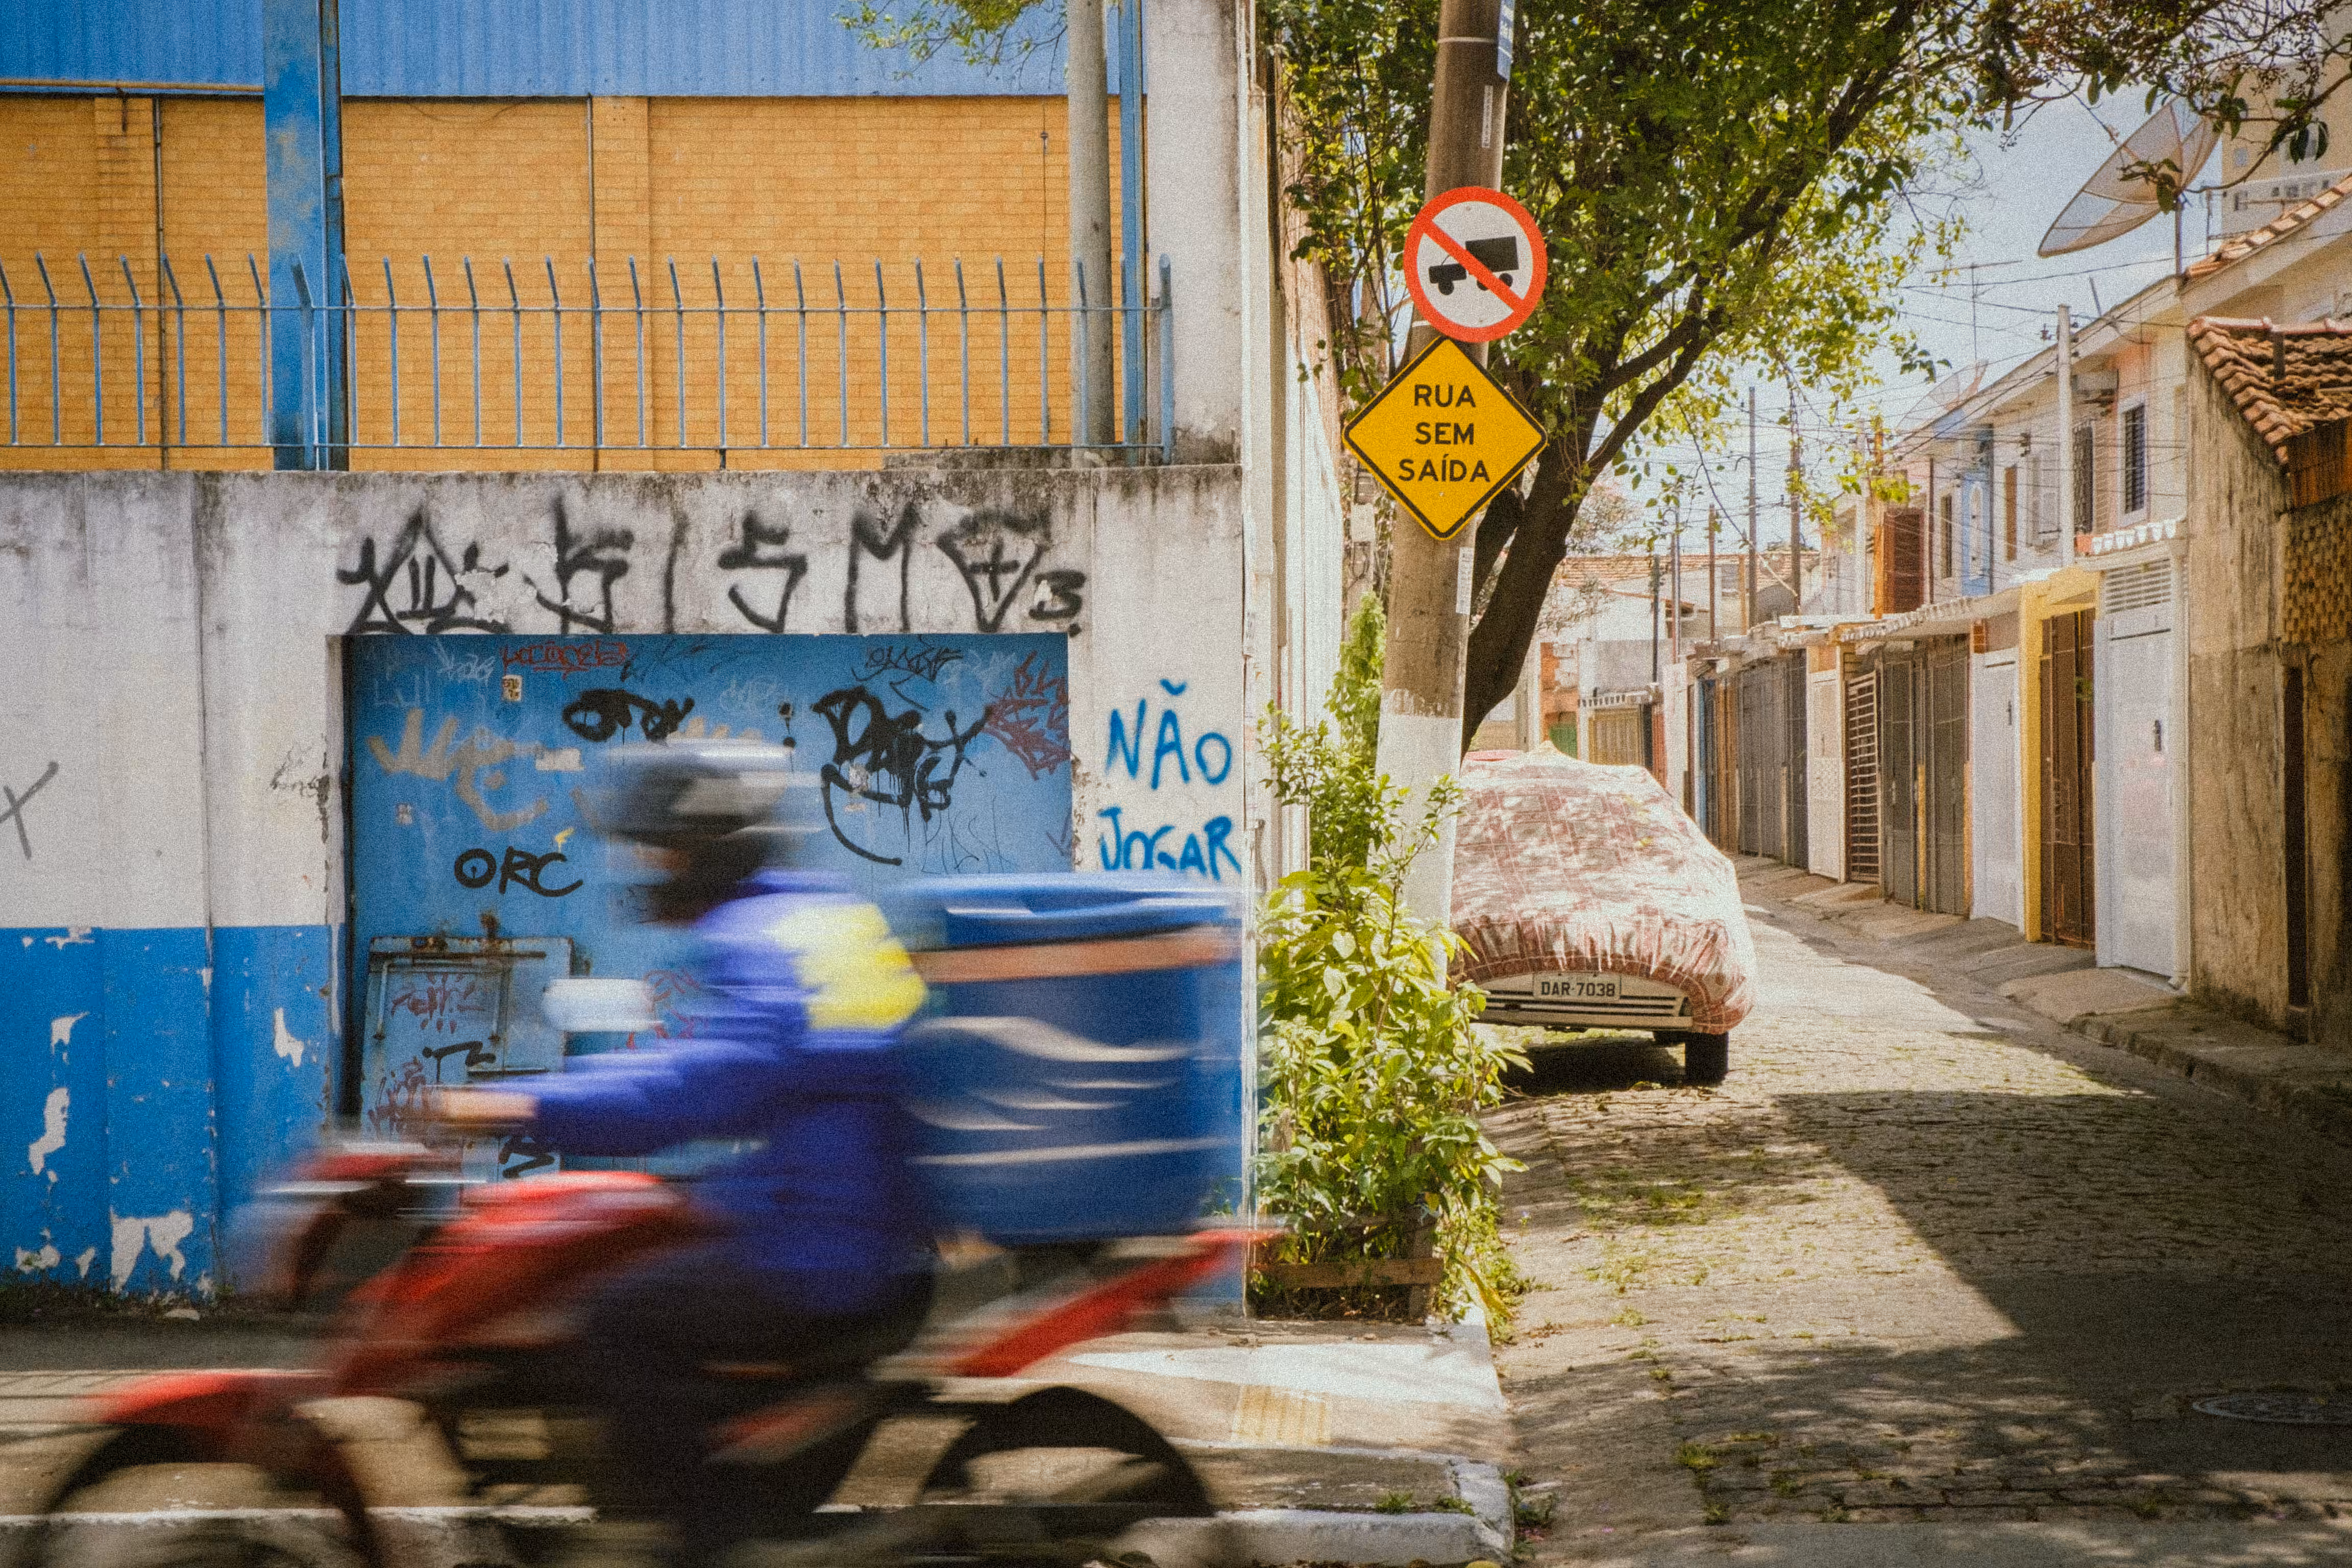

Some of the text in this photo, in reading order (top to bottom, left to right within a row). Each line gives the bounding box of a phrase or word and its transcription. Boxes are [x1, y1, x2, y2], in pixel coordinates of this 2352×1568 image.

[1414, 384, 1477, 408] RUA
[1415, 422, 1475, 445] SEM
[1398, 453, 1490, 482] SAÍDA
[1104, 678, 1233, 791] NÃO
[1097, 806, 1242, 882] JOGAR
[1540, 981, 1615, 997] DAR 7038
